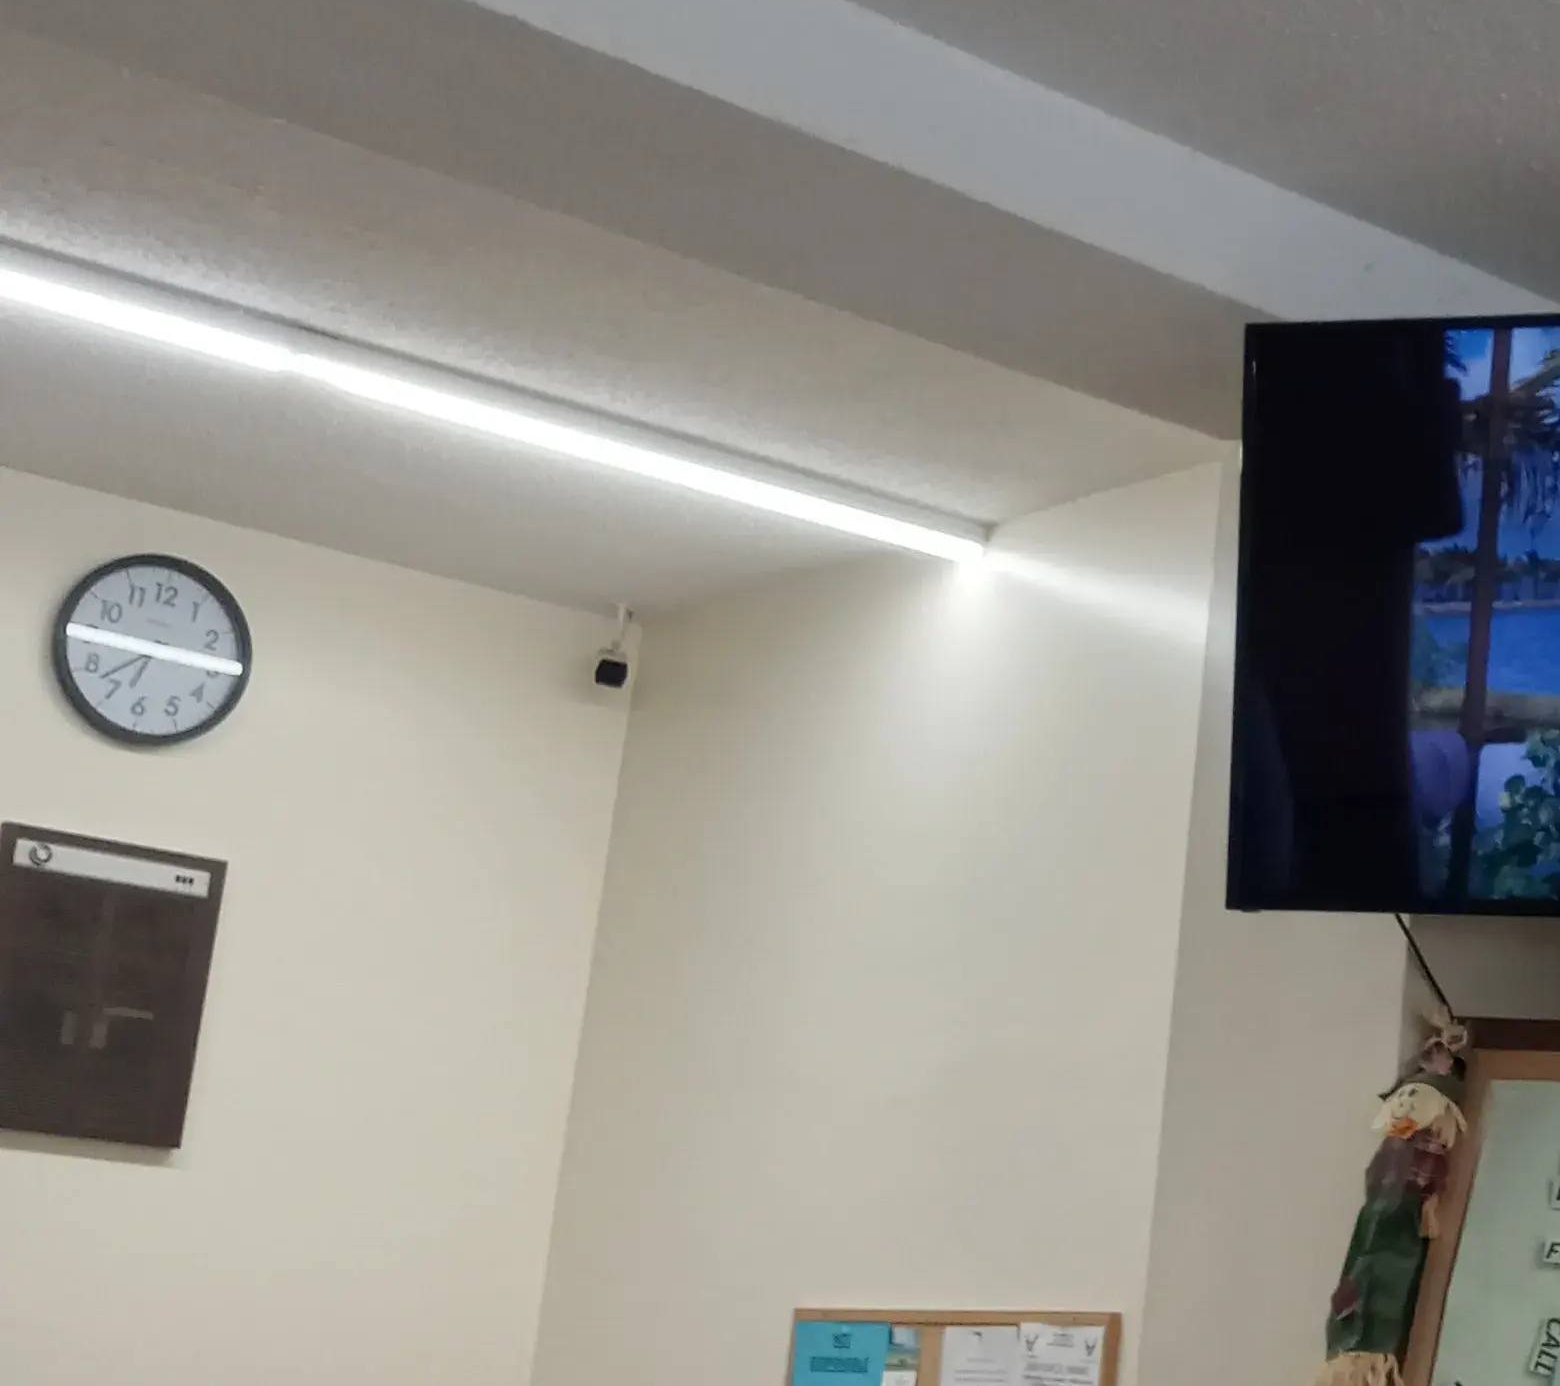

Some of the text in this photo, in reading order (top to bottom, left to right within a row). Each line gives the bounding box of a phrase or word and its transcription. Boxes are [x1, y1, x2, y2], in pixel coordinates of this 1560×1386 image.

[128, 583, 147, 608] 11
[154, 582, 179, 608] 12
[100, 599, 124, 624] 10
[190, 601, 200, 622] 1
[204, 629, 220, 651] 2
[85, 653, 100, 674] 8
[104, 678, 122, 700] 7
[189, 680, 206, 703] 4
[130, 694, 147, 717] 6
[164, 694, 181, 717] 5
